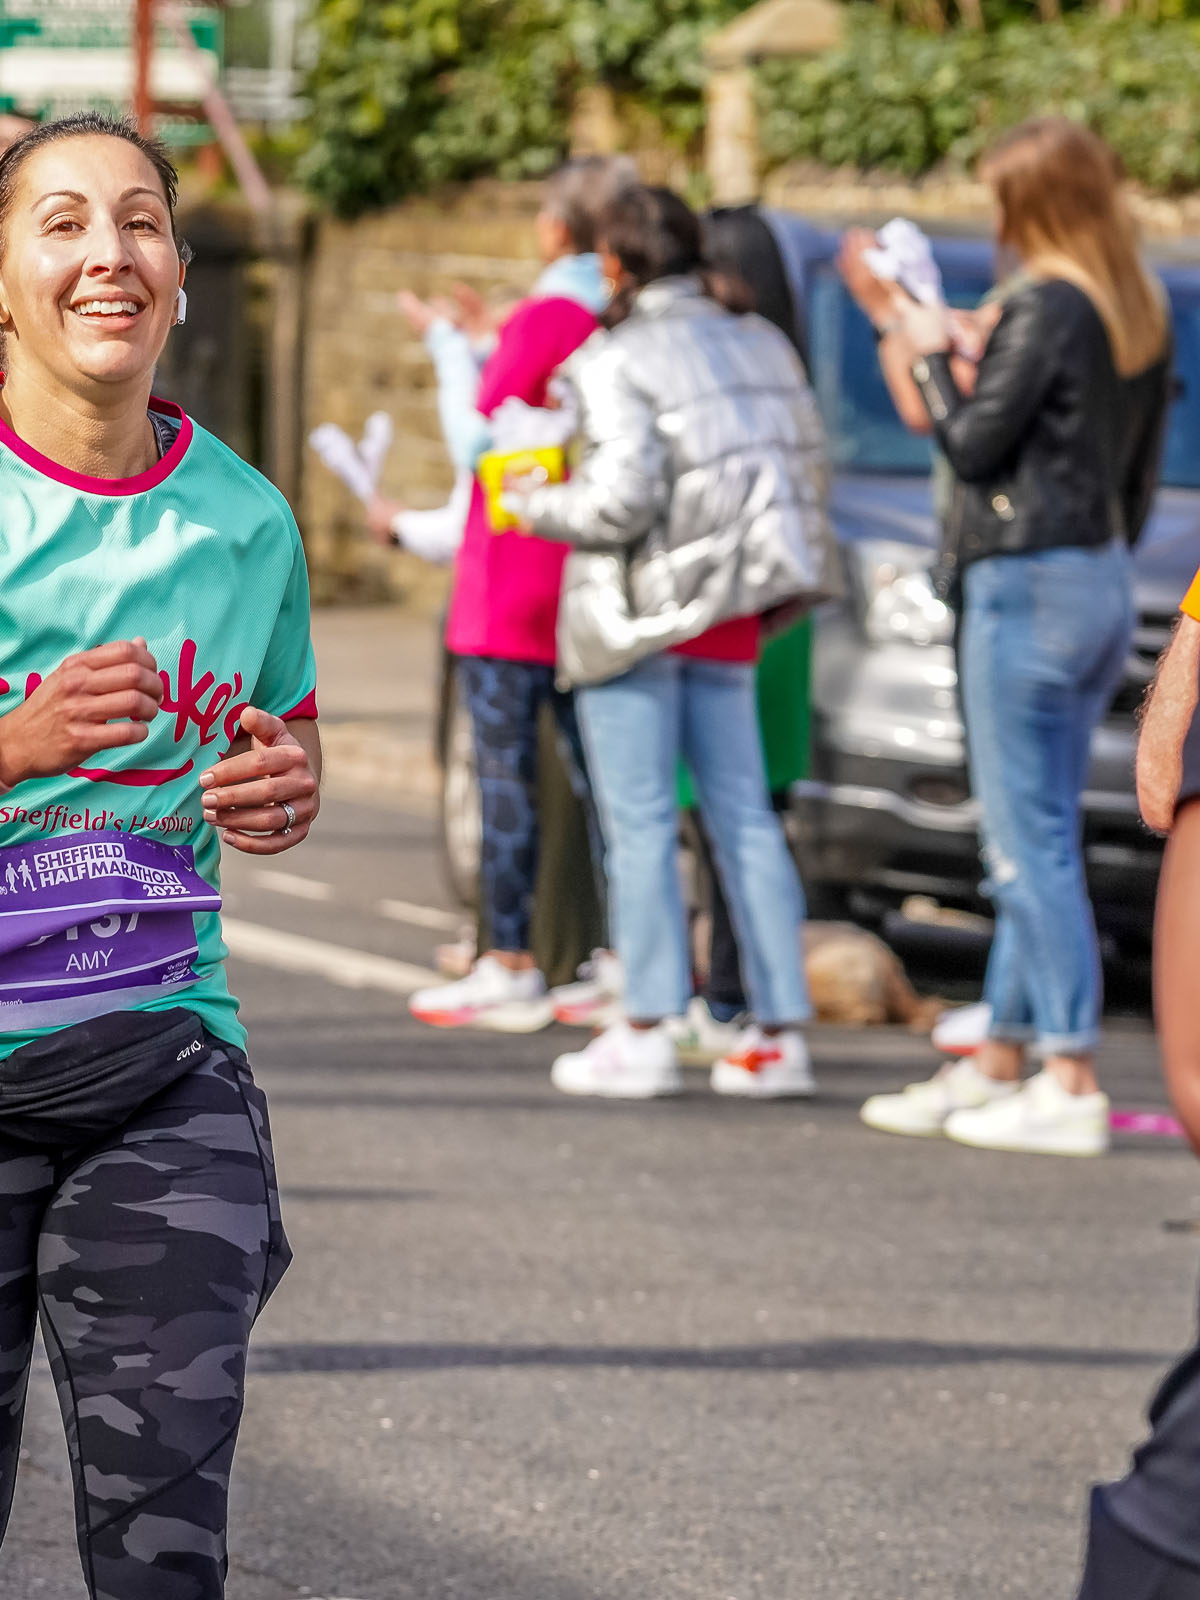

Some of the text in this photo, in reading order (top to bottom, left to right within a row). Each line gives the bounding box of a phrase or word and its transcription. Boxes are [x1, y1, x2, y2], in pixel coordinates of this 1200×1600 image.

[128, 810, 194, 836] Hospice
[36, 845, 123, 870] SHEFFIELD
[39, 862, 87, 888] HALF
[92, 860, 178, 885] MARATHON
[143, 883, 191, 897] 2022
[65, 948, 114, 972] AMY
